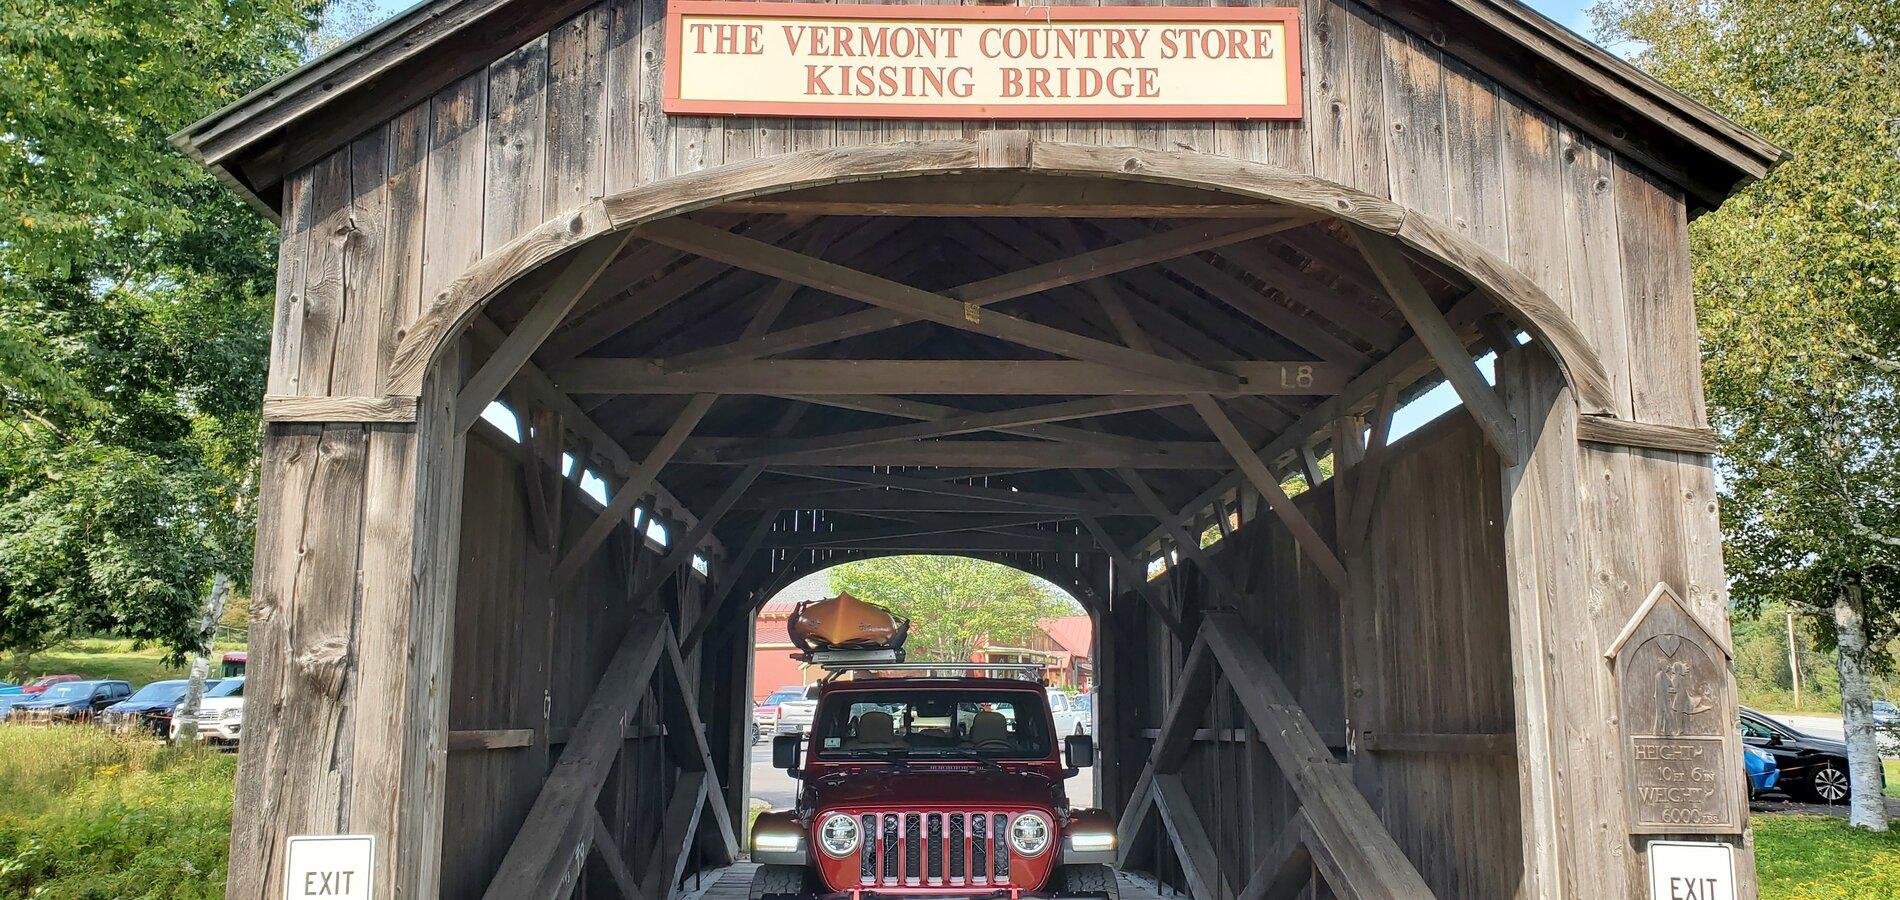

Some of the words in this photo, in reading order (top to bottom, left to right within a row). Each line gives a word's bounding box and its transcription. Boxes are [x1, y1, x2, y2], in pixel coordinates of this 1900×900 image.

[690, 23, 764, 55] THE
[781, 25, 963, 58] VERMONT
[979, 27, 1150, 59] COUNTRY
[1160, 28, 1274, 59] STORE
[804, 64, 976, 98] KISSING
[999, 67, 1161, 98] BRIDGE
[1634, 744, 1696, 761] HEIGHT
[1637, 786, 1703, 804] WEIGHT
[304, 870, 355, 896] EXIT
[1670, 876, 1718, 900] EXIT
